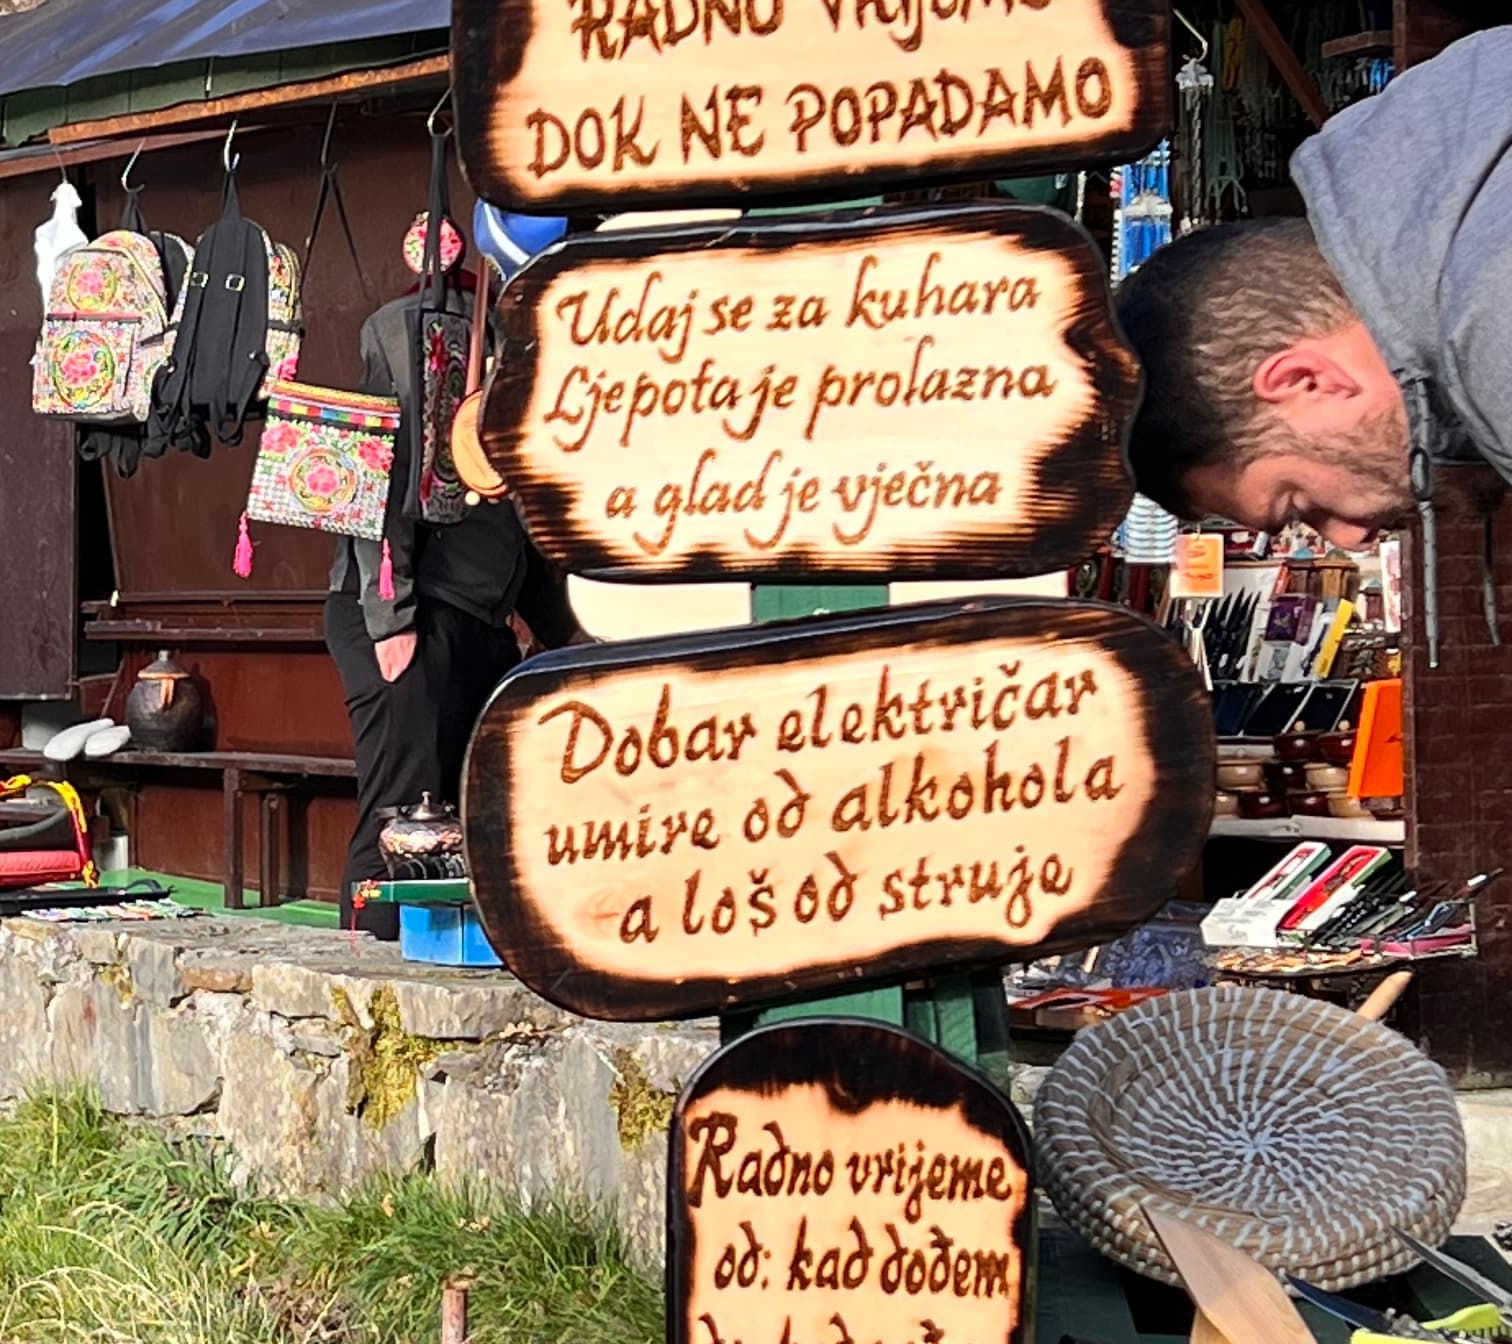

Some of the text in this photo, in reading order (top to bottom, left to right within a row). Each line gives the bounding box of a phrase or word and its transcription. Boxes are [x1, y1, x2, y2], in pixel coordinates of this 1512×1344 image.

[526, 55, 1114, 178] DOK NE POPADAMO
[556, 251, 1042, 364] Udaj se za kuhara
[544, 336, 1059, 453] Ljepota je prolazna
[606, 449, 1002, 556] a glad je vječna
[537, 660, 1099, 786] Dobar električar
[545, 735, 1124, 867] umire od alkohola
[617, 842, 1075, 945] a loš od struje
[686, 1110, 1013, 1224] Radno vrijeme
[714, 1220, 771, 1292] od:
[786, 1215, 874, 1294] kad
